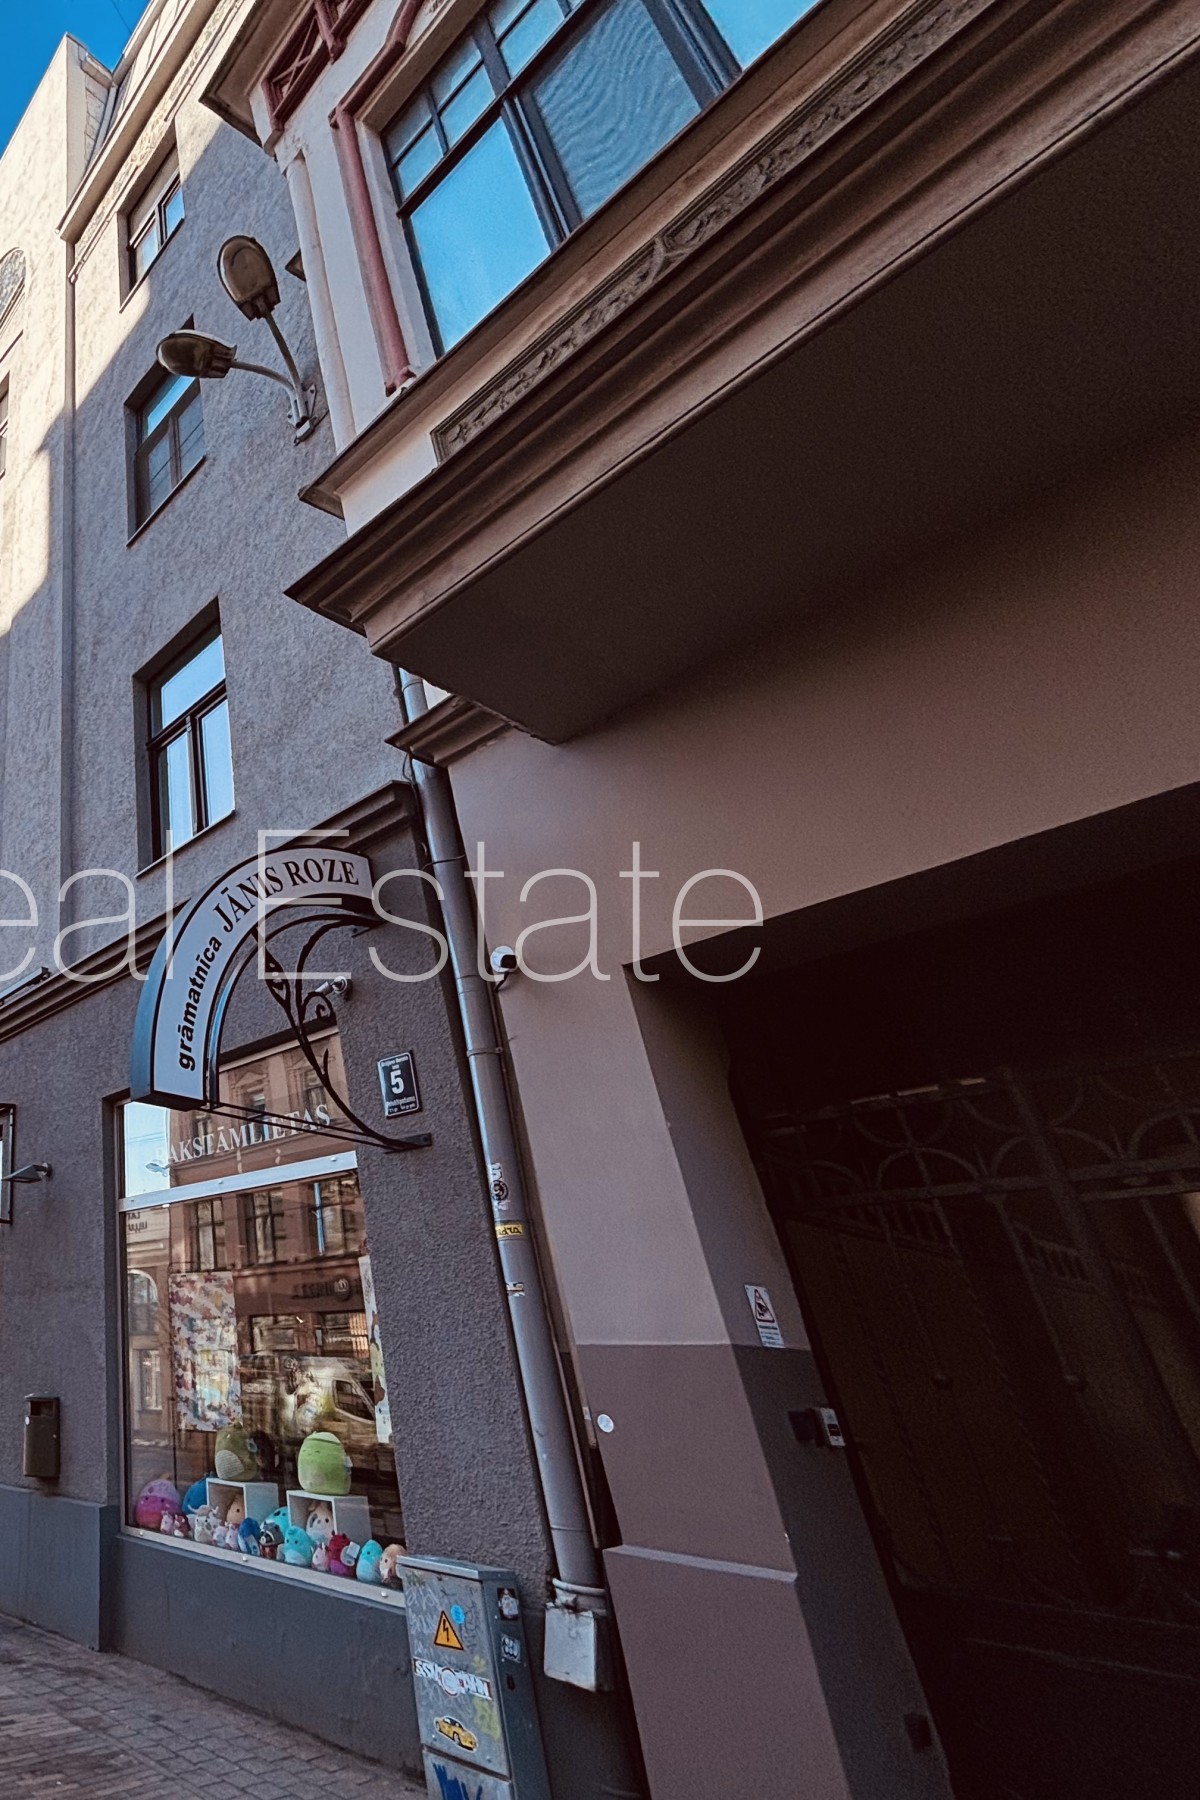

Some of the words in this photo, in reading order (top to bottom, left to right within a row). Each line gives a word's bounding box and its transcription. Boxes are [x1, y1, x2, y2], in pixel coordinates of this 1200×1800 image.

[178, 936, 222, 1072] grāmatnīca
[213, 866, 284, 933] JĀNIS
[282, 858, 359, 887] ROZE
[390, 1069, 404, 1094] 5
